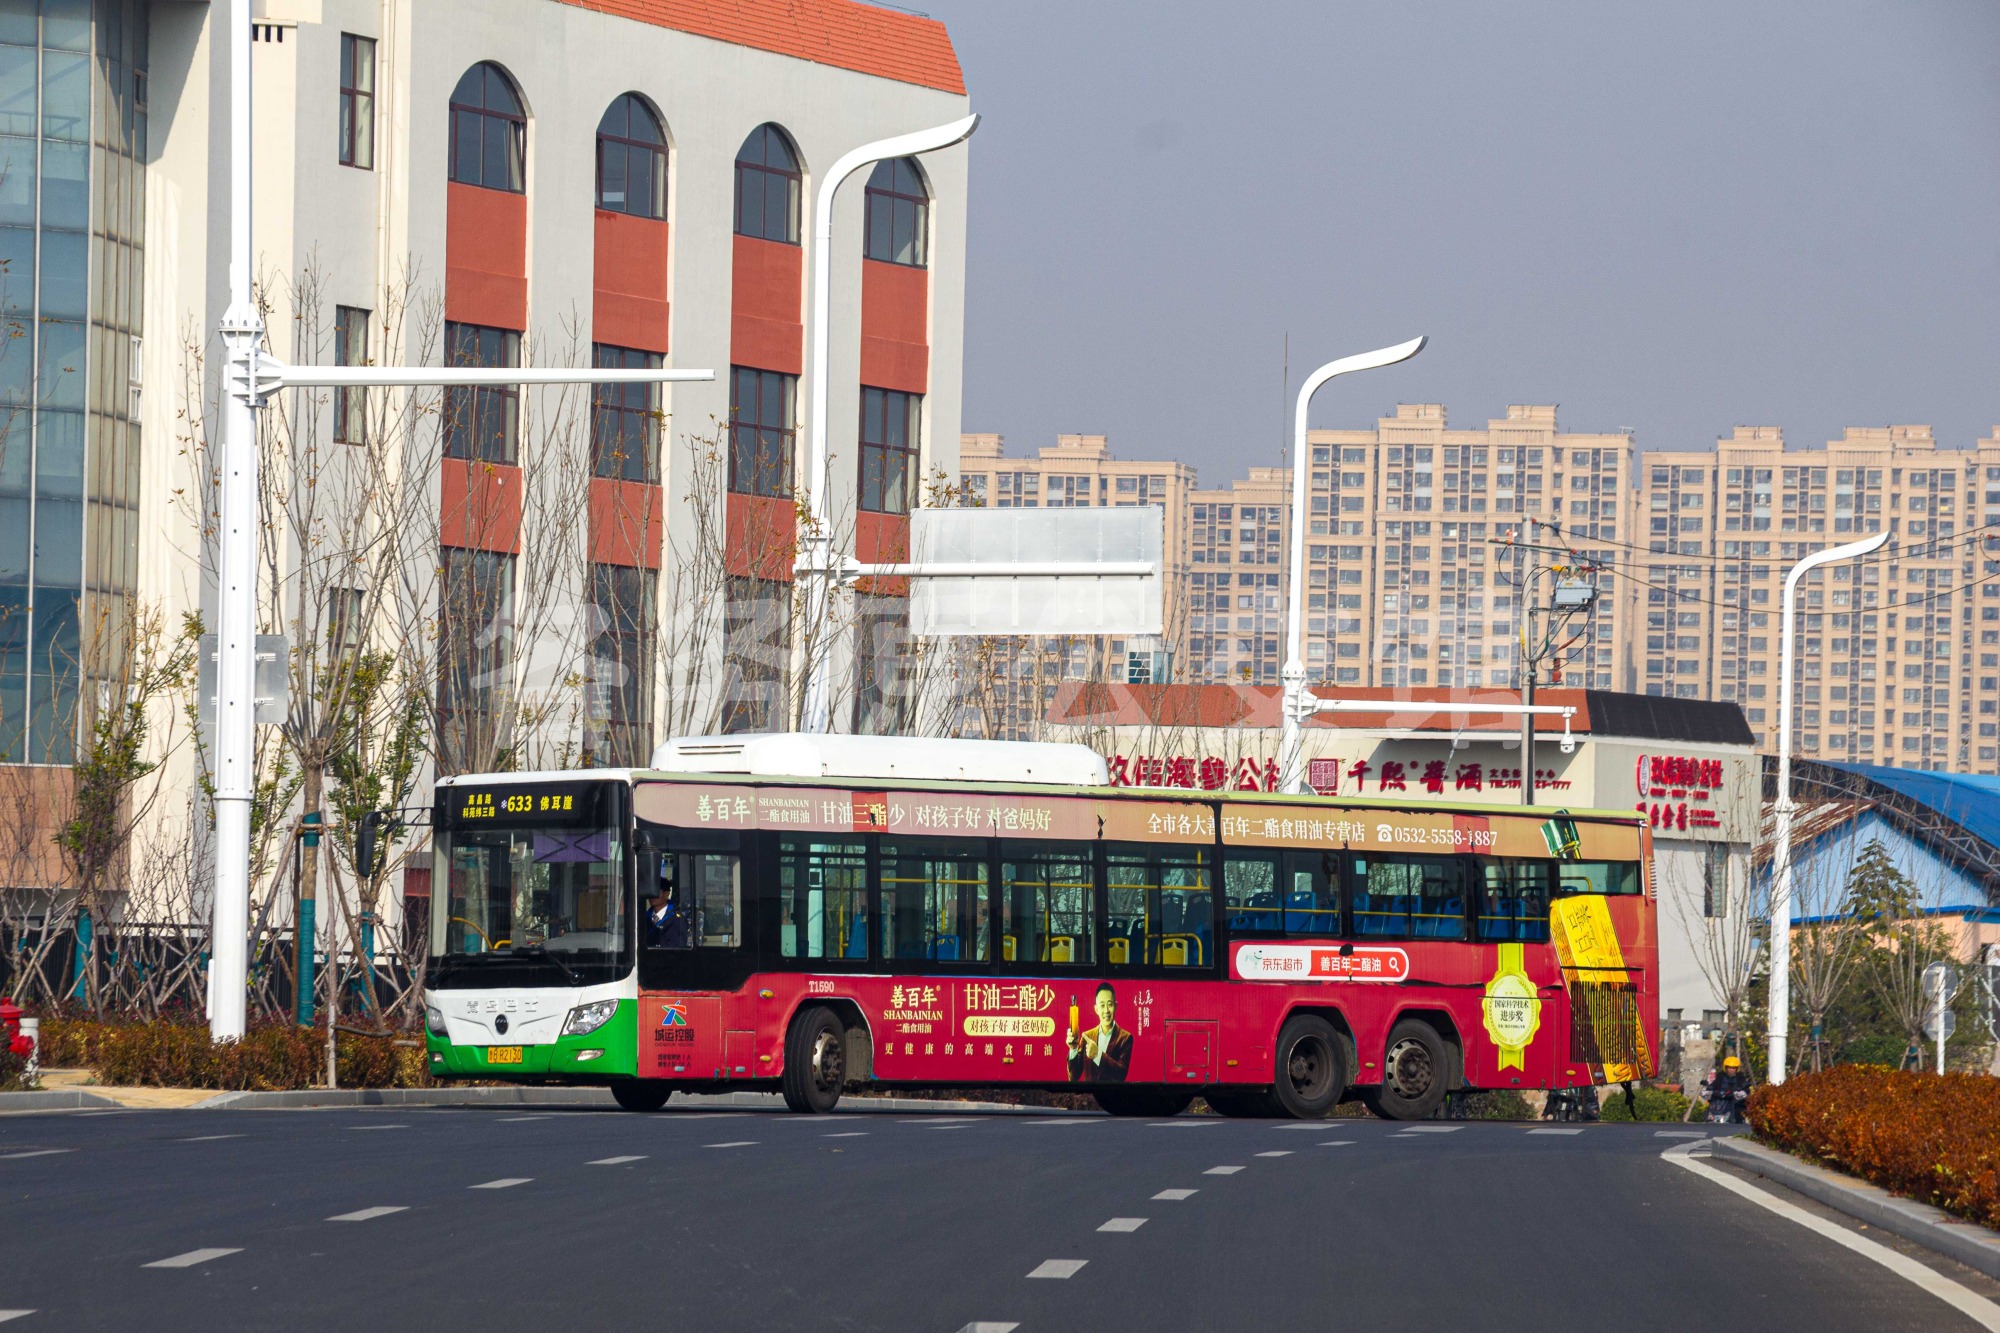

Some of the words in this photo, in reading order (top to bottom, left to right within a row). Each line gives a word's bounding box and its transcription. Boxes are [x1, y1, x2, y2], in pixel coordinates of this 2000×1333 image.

[507, 796, 532, 812] 633
[540, 795, 572, 811] 佛耳崖
[696, 795, 752, 824] 善百年
[758, 797, 810, 809] SHANBAINIAN
[759, 809, 810, 824] 二酯食用油
[822, 801, 905, 829] 甘油三酯少
[914, 807, 982, 829] 对孩子好
[986, 808, 1052, 832] 对爸妈好
[1147, 813, 1365, 843] 全市各大善百年二酯食用油专营店
[1394, 827, 1497, 846] 0532-5558-1887
[1262, 957, 1303, 972] 京东超市
[1320, 957, 1381, 972] 善百年二酯油
[808, 980, 835, 993] T1590
[890, 984, 937, 1010] 善百年
[963, 983, 1056, 1012] 甘油三酯少
[1494, 999, 1529, 1009] 国家科学技术
[883, 1010, 943, 1021] SHANBAINIAN
[1500, 1010, 1523, 1022] 进步奖
[895, 1023, 932, 1034] 二酯食用油
[970, 1020, 1008, 1034] 对孩子好
[1011, 1020, 1050, 1034] 对爸妈好
[654, 1028, 695, 1042] 城运控股
[884, 1042, 1053, 1056] 更健康的高端食用油
